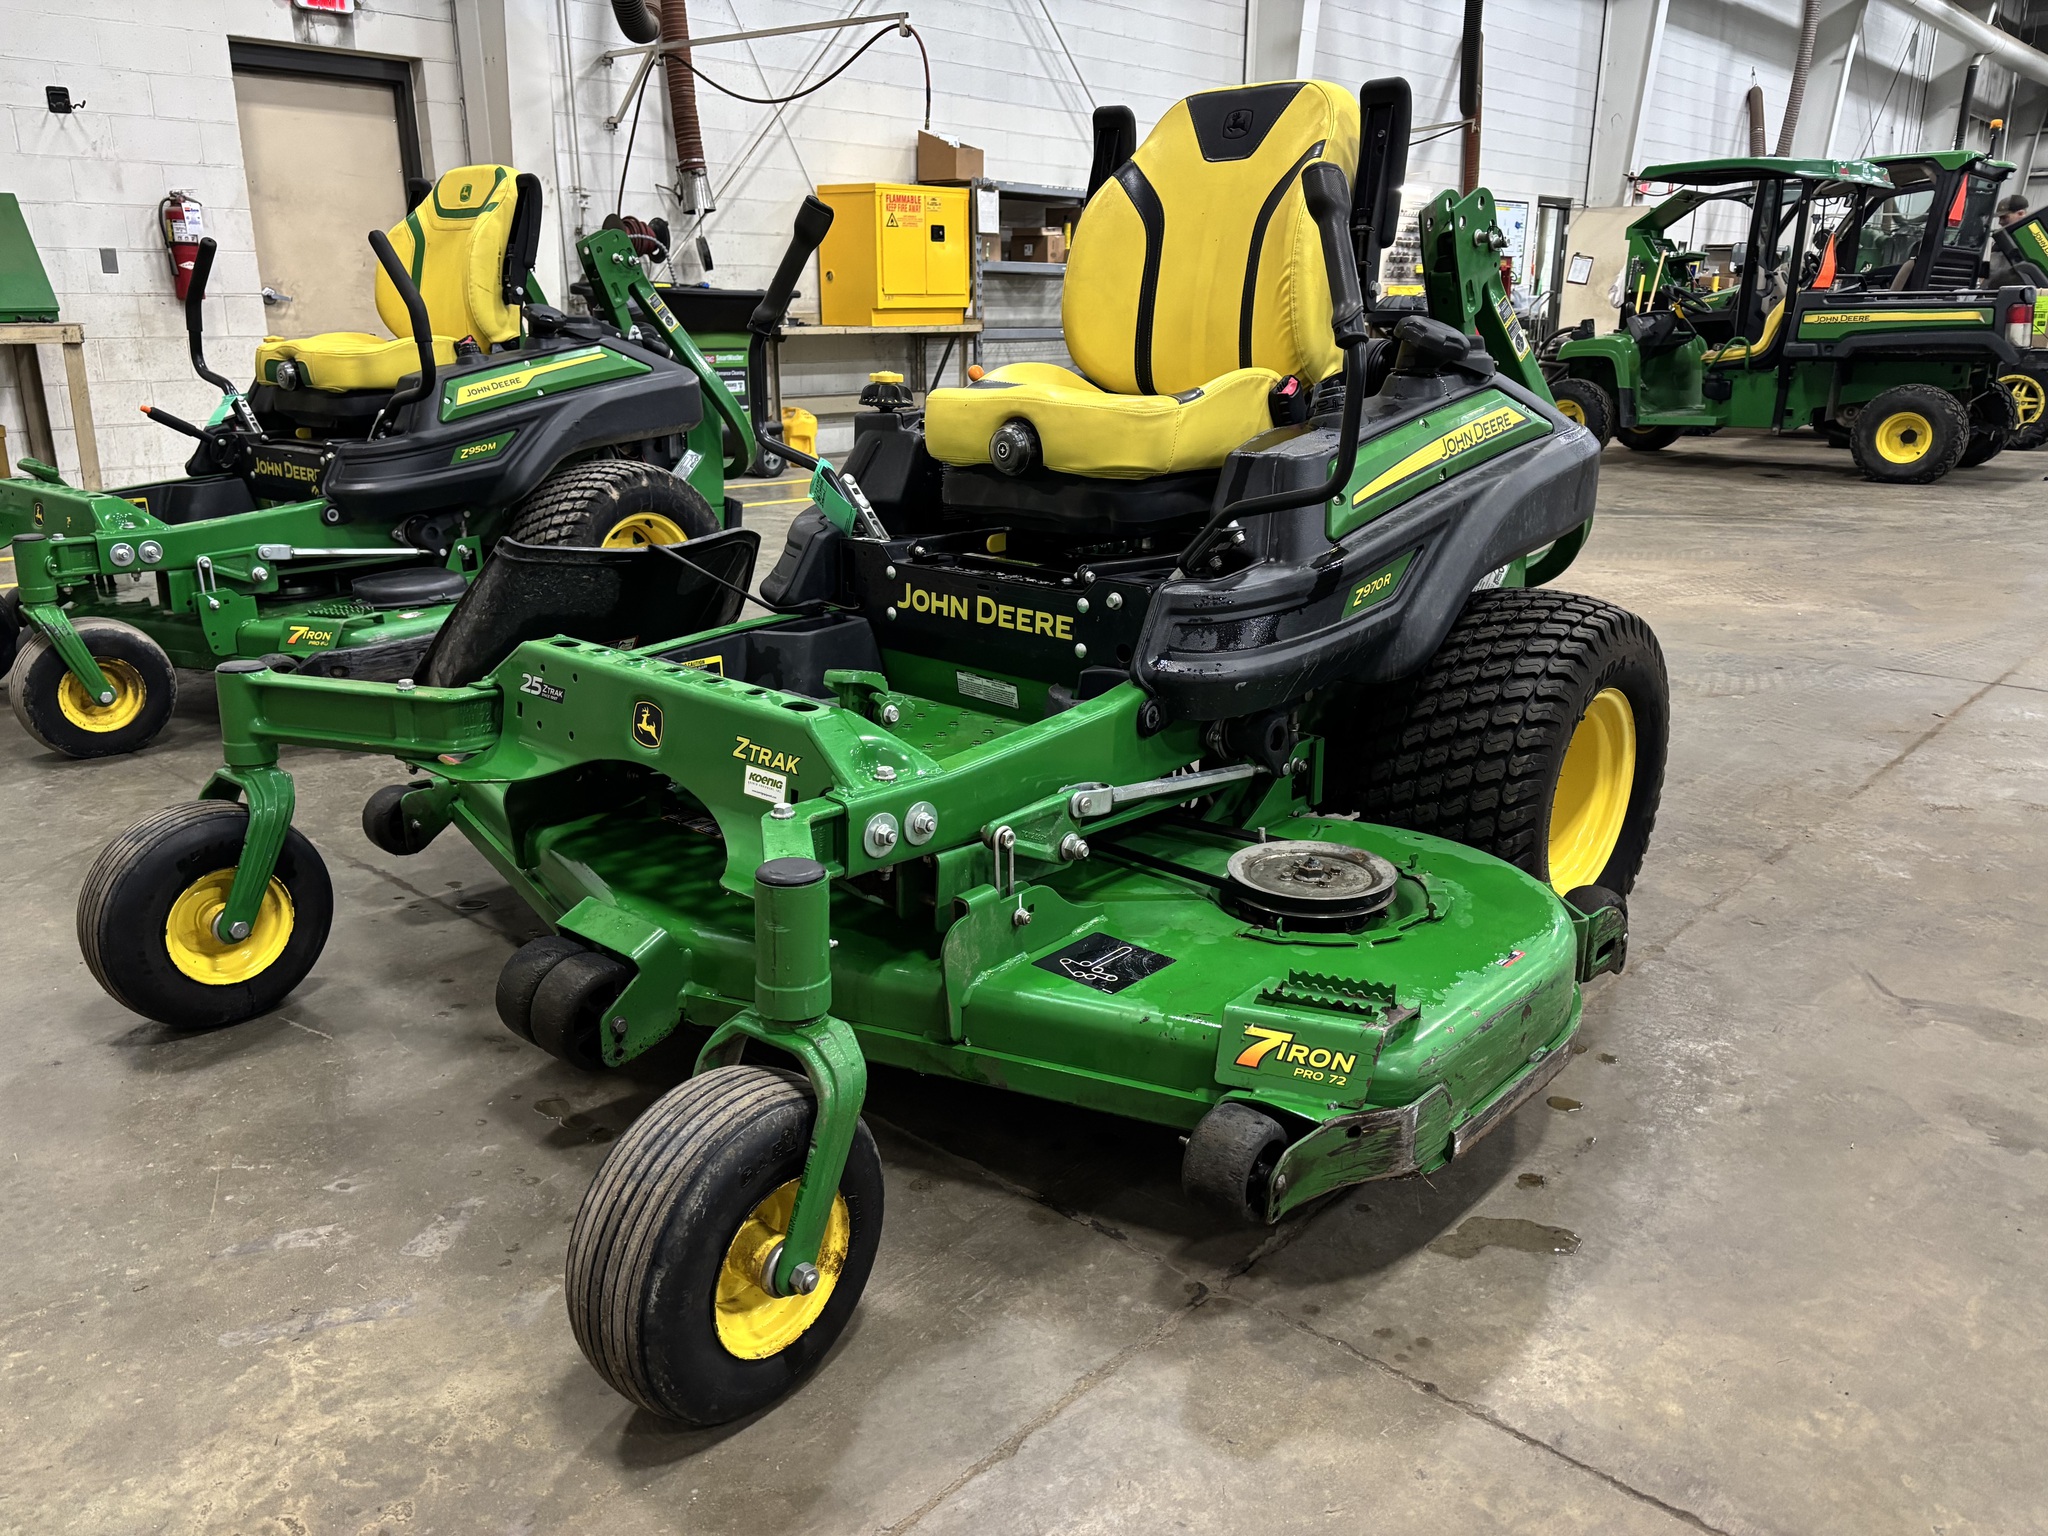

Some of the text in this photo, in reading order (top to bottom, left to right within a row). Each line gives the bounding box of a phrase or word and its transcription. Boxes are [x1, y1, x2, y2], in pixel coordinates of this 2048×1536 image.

[886, 194, 921, 204] FLAMMABLE
[898, 203, 907, 212] FIRE
[466, 377, 522, 397] JOHN DEERE
[1441, 413, 1512, 458] JOHN DEERE
[460, 442, 496, 459] Z950M
[254, 457, 282, 477] JOHN
[1352, 573, 1392, 607] Z970R
[897, 582, 1074, 640] JOHN DEERE
[520, 673, 564, 698] 25 ZTRAK
[732, 735, 801, 775] ZTRAK
[1293, 1067, 1347, 1086] PRO 72
